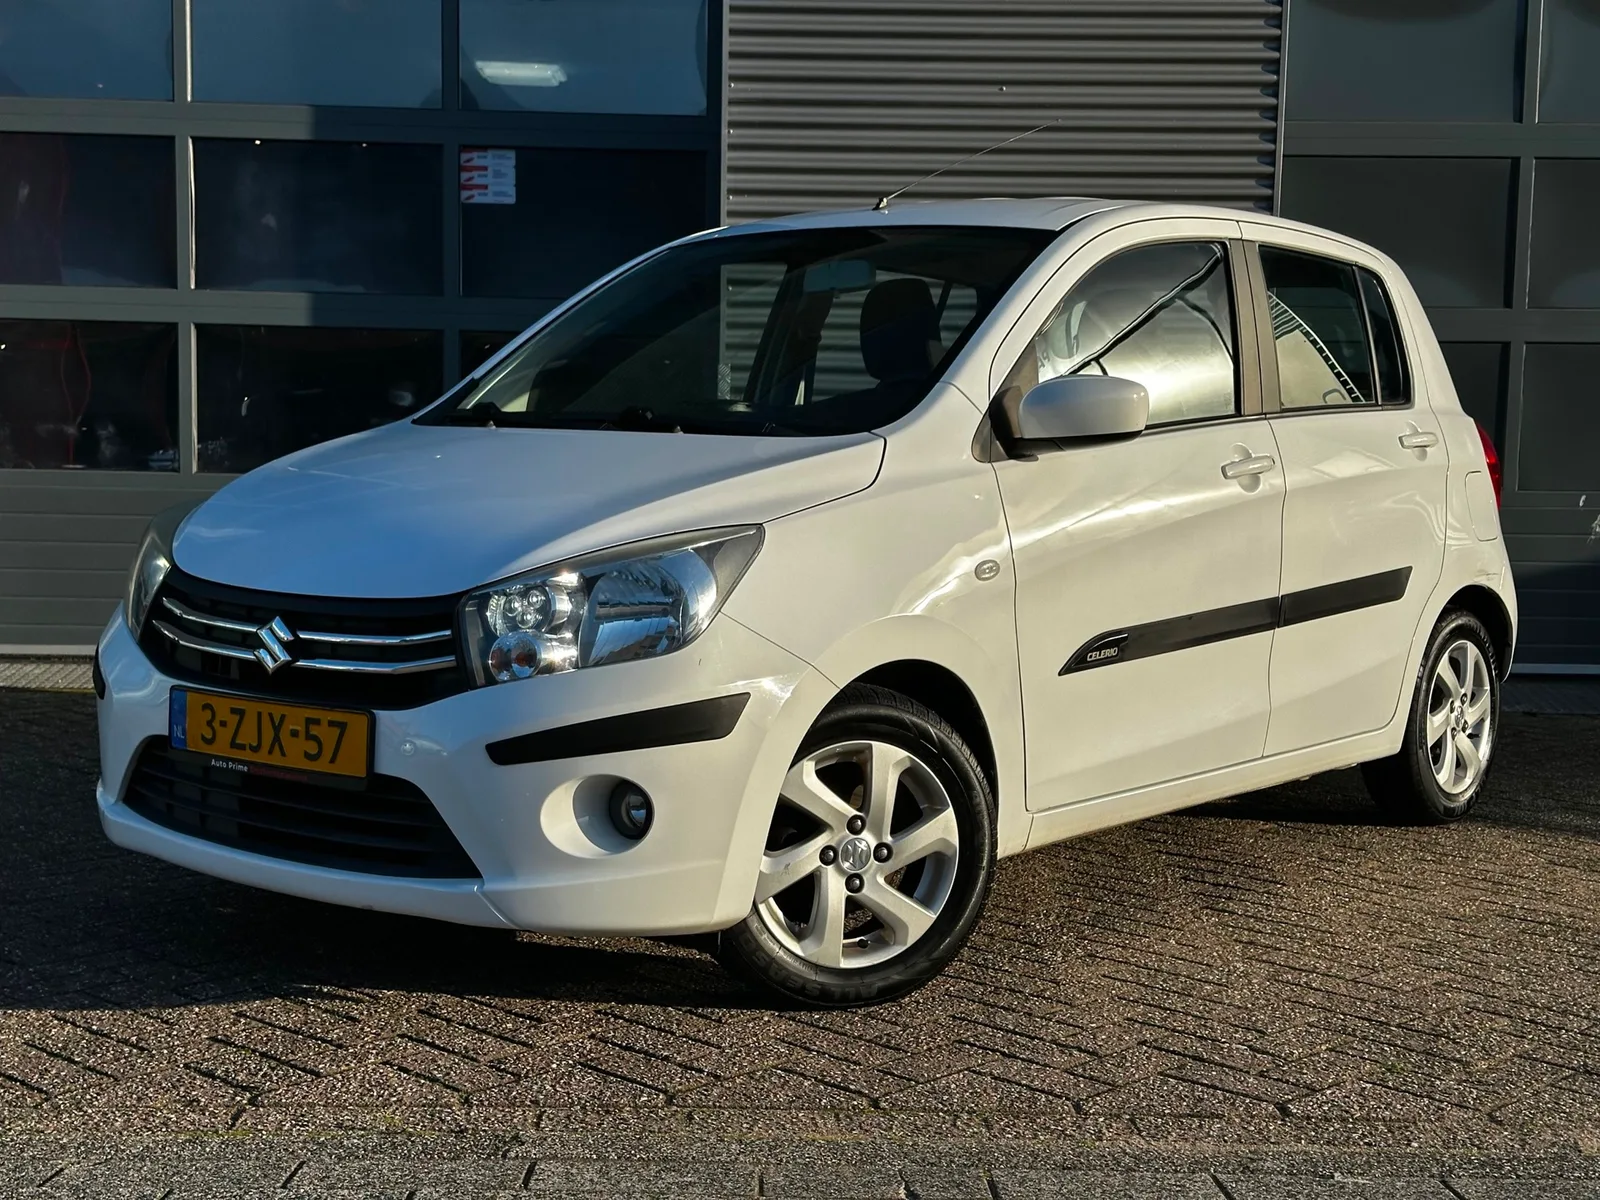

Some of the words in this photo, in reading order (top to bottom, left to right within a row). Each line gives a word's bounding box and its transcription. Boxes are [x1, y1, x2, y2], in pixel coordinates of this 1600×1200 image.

[1086, 646, 1118, 661] CELERIO
[173, 724, 185, 739] NL
[200, 702, 348, 765] 3-ZJX-57
[211, 758, 227, 768] Auto
[228, 761, 249, 772] Prime
[736, 929, 822, 997] SEASO
